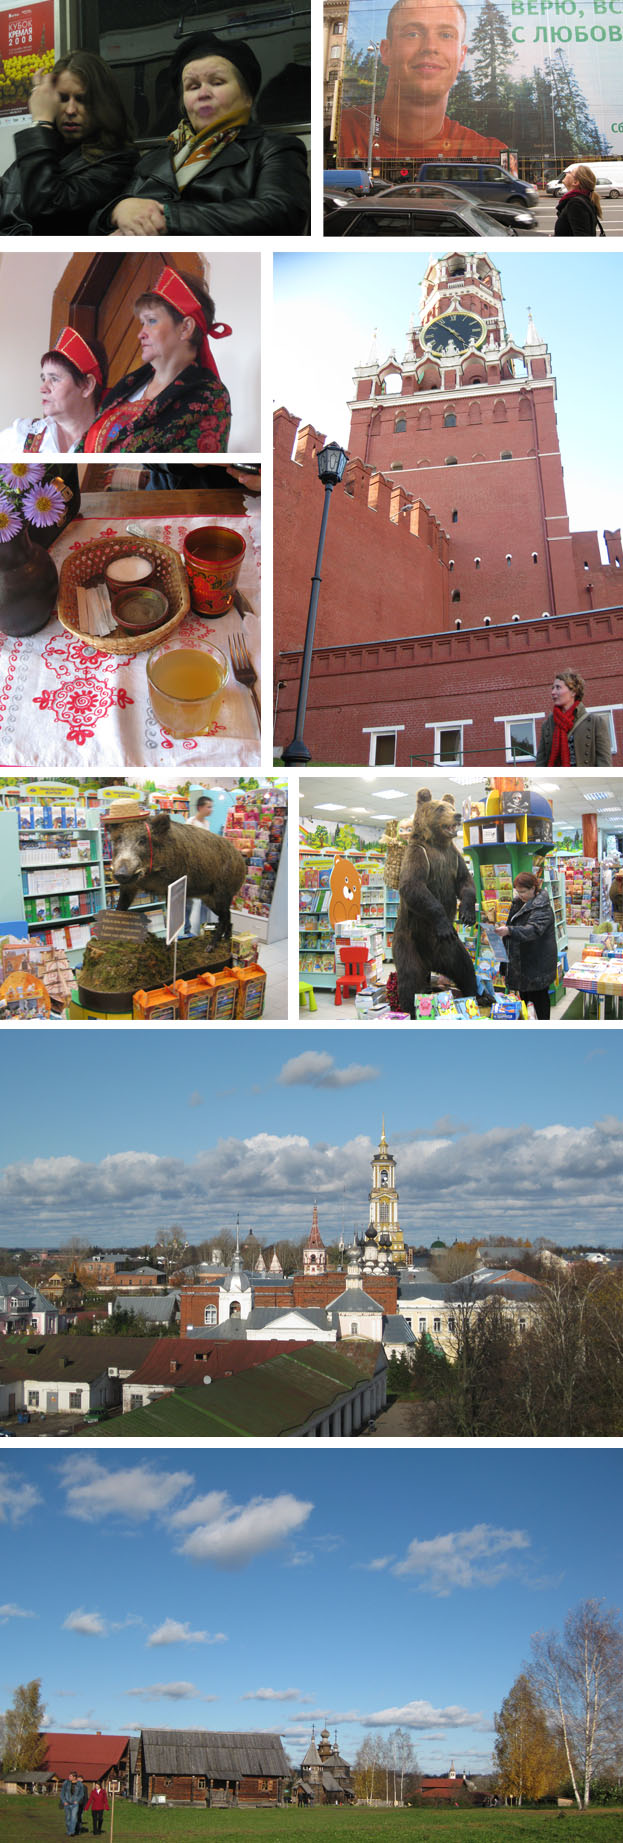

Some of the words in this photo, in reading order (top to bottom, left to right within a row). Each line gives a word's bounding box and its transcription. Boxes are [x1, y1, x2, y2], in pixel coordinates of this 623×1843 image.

[511, 0, 585, 18] ВЕРЮ,
[9, 20, 32, 31] КУБОК
[9, 27, 32, 38] КРЕМЛЯ
[512, 26, 525, 43] С
[533, 25, 623, 43] ЛЮБОВ
